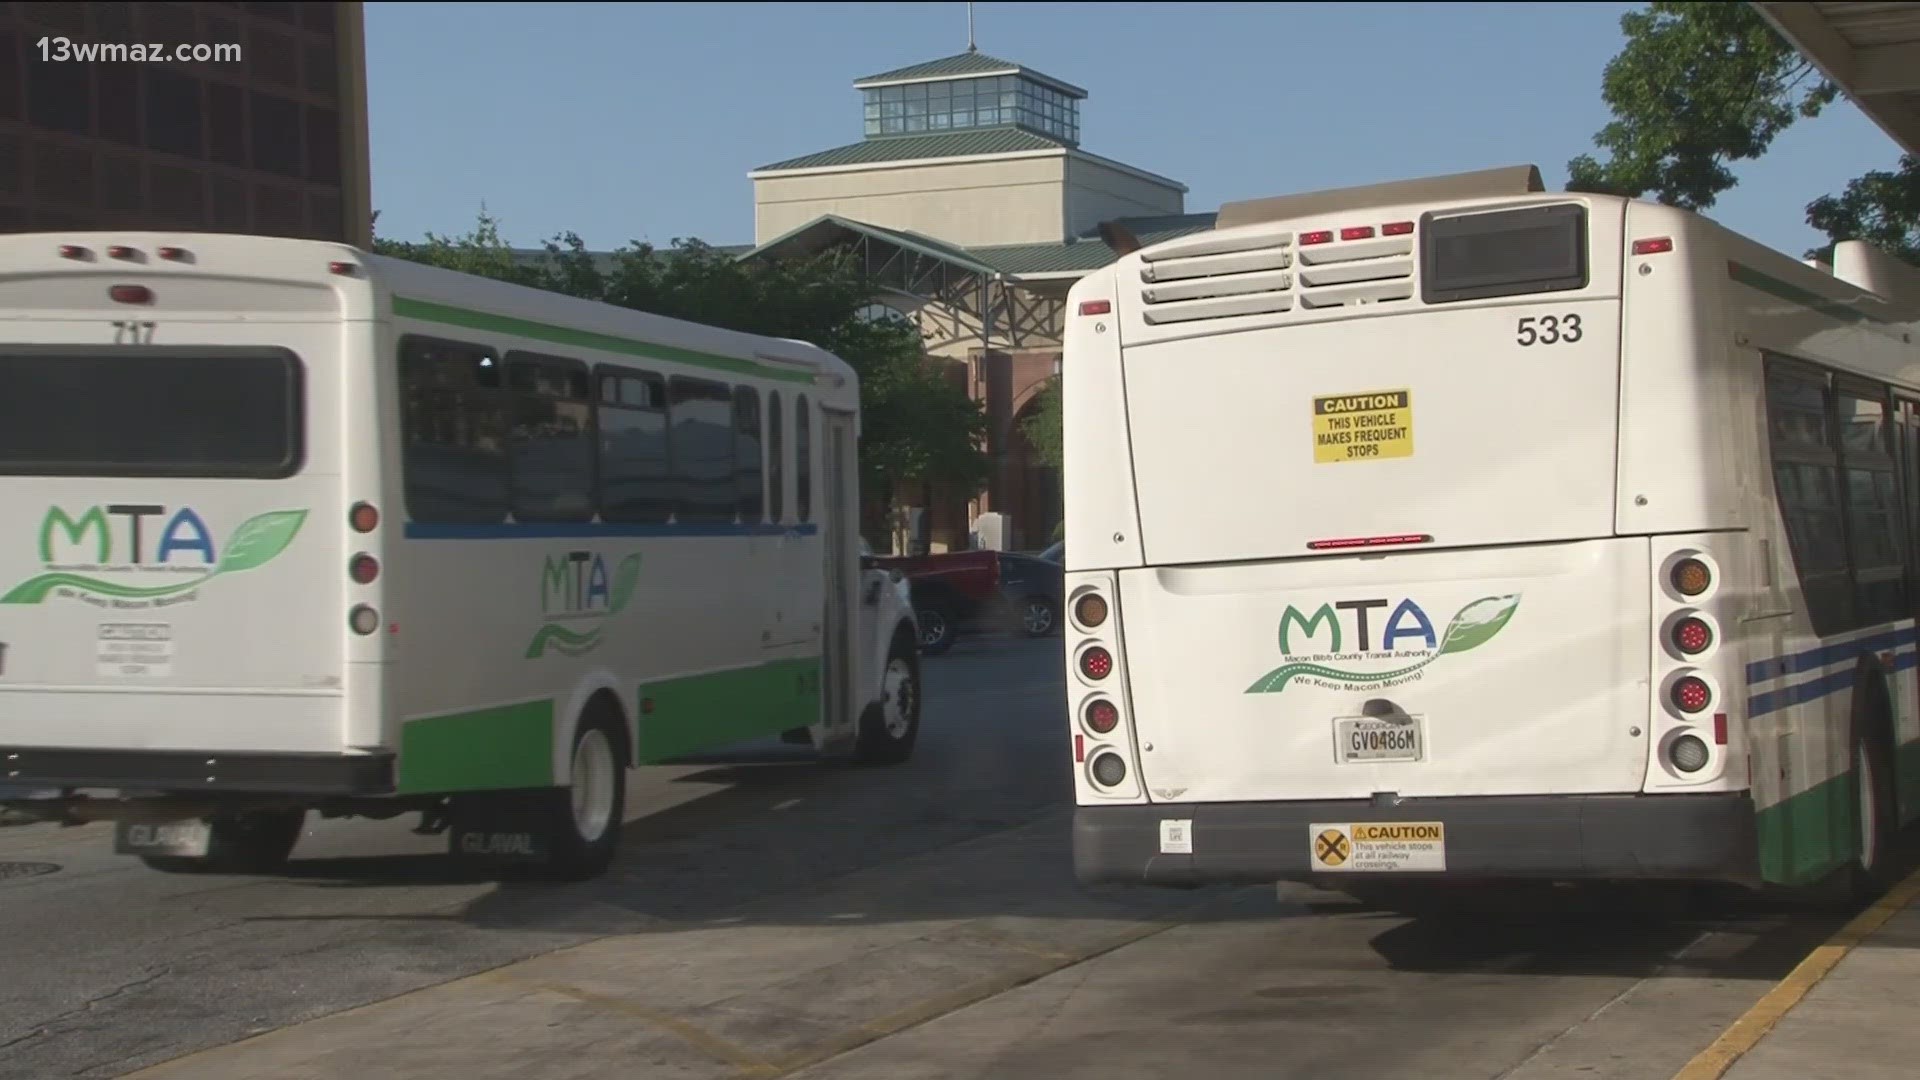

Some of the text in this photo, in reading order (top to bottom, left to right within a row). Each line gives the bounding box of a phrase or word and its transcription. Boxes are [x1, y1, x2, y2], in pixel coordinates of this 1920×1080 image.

[112, 321, 156, 345] 717
[1517, 313, 1583, 347] 533
[1323, 394, 1399, 413] CAUTION
[1328, 413, 1396, 430] THIS VEHICLE
[1317, 427, 1407, 446] MAKES FREQUENT
[1347, 444, 1379, 457] STOPS
[39, 505, 215, 564] MTA
[542, 551, 609, 612] MTA
[1279, 598, 1437, 655] MTA
[1285, 655, 1311, 663] Macon
[1334, 652, 1362, 661] County
[1366, 651, 1391, 659] Transit
[1395, 650, 1431, 658] Authority
[1294, 669, 1424, 692] We Keep Macon Moving!
[1368, 826, 1439, 839] CAUTION
[1355, 842, 1433, 851] This vehicle stops
[1365, 851, 1376, 859] all
[1377, 851, 1410, 860] railway
